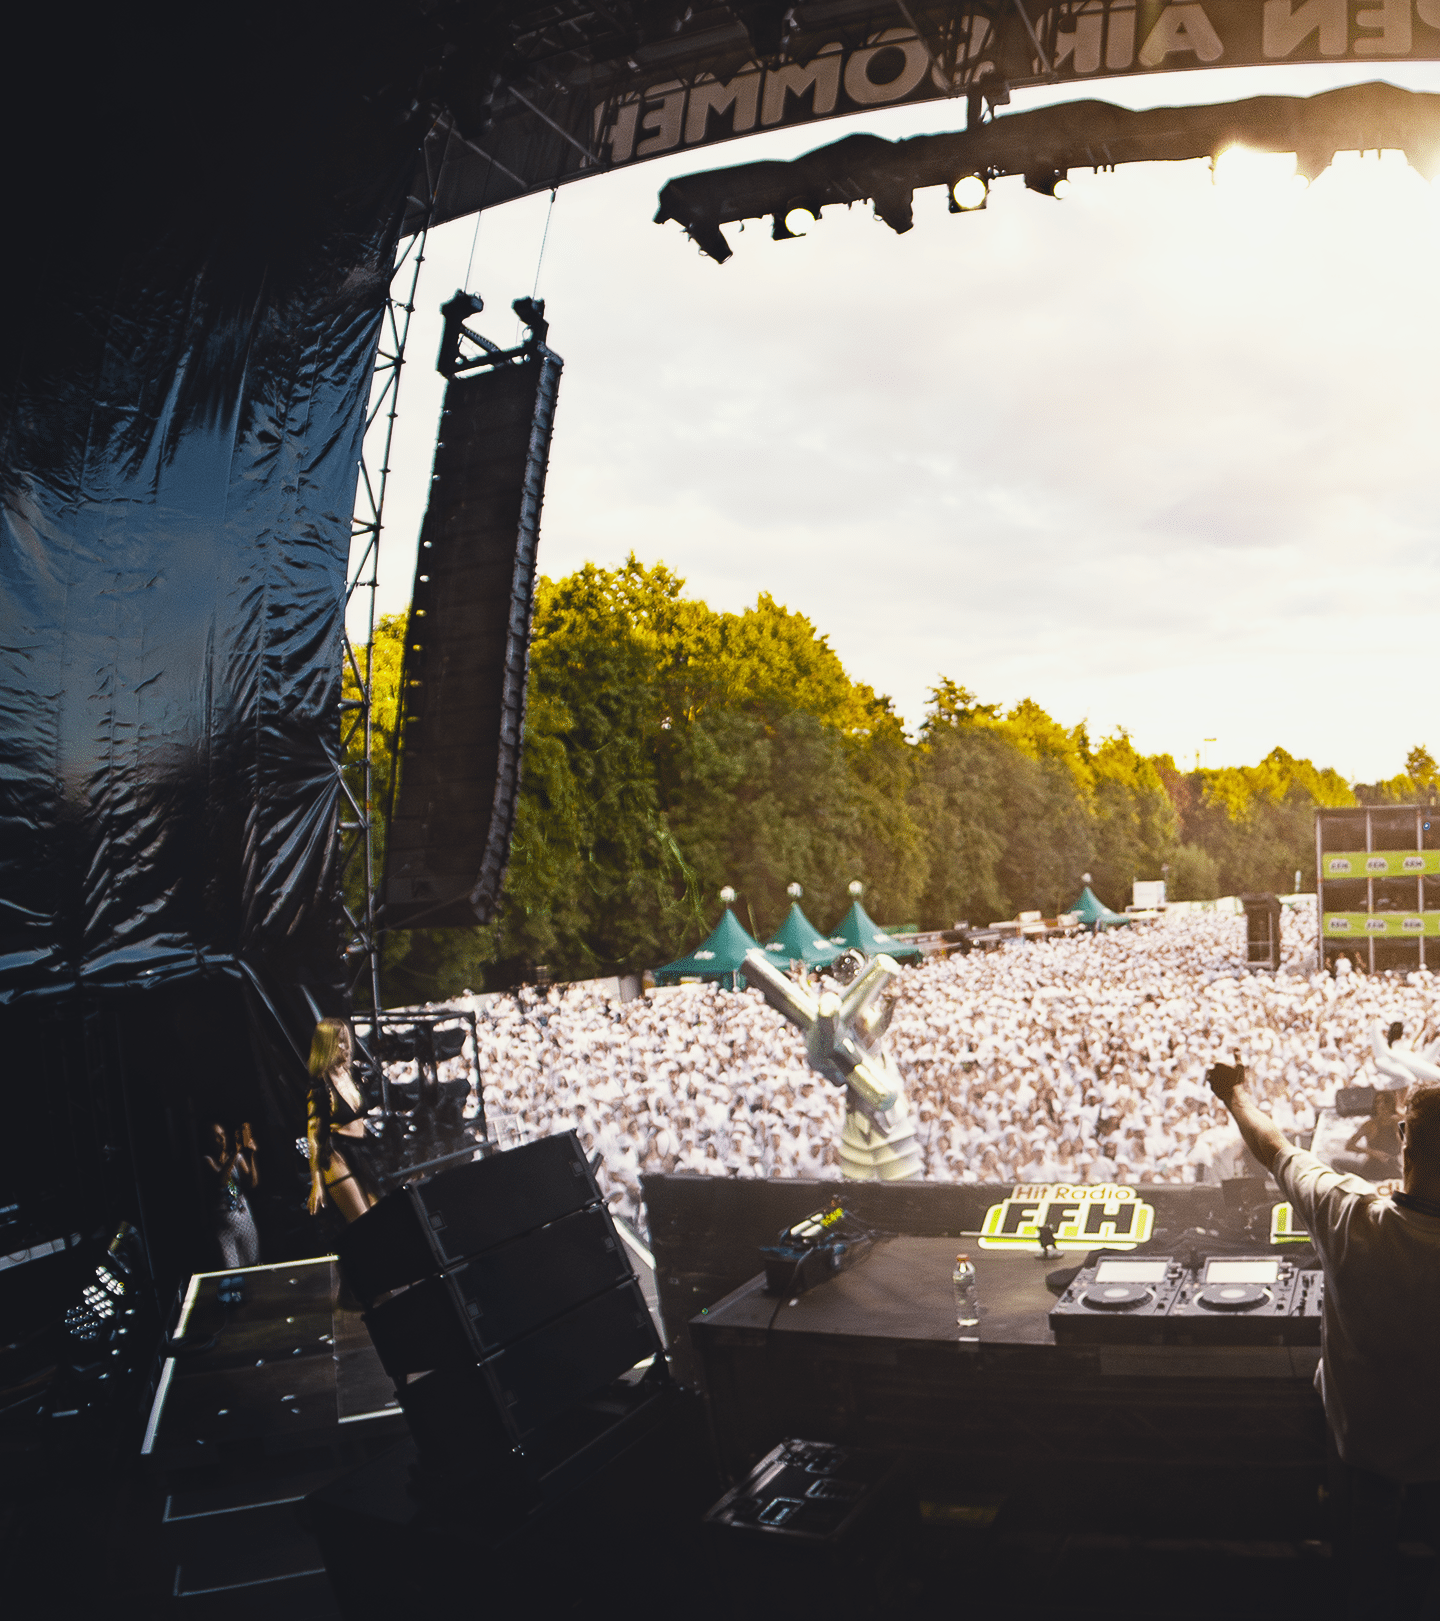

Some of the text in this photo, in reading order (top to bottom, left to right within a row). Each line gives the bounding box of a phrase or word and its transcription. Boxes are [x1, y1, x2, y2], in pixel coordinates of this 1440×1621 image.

[1016, 1186, 1131, 1200] Hit Radio
[1001, 1202, 1137, 1235] FFH
